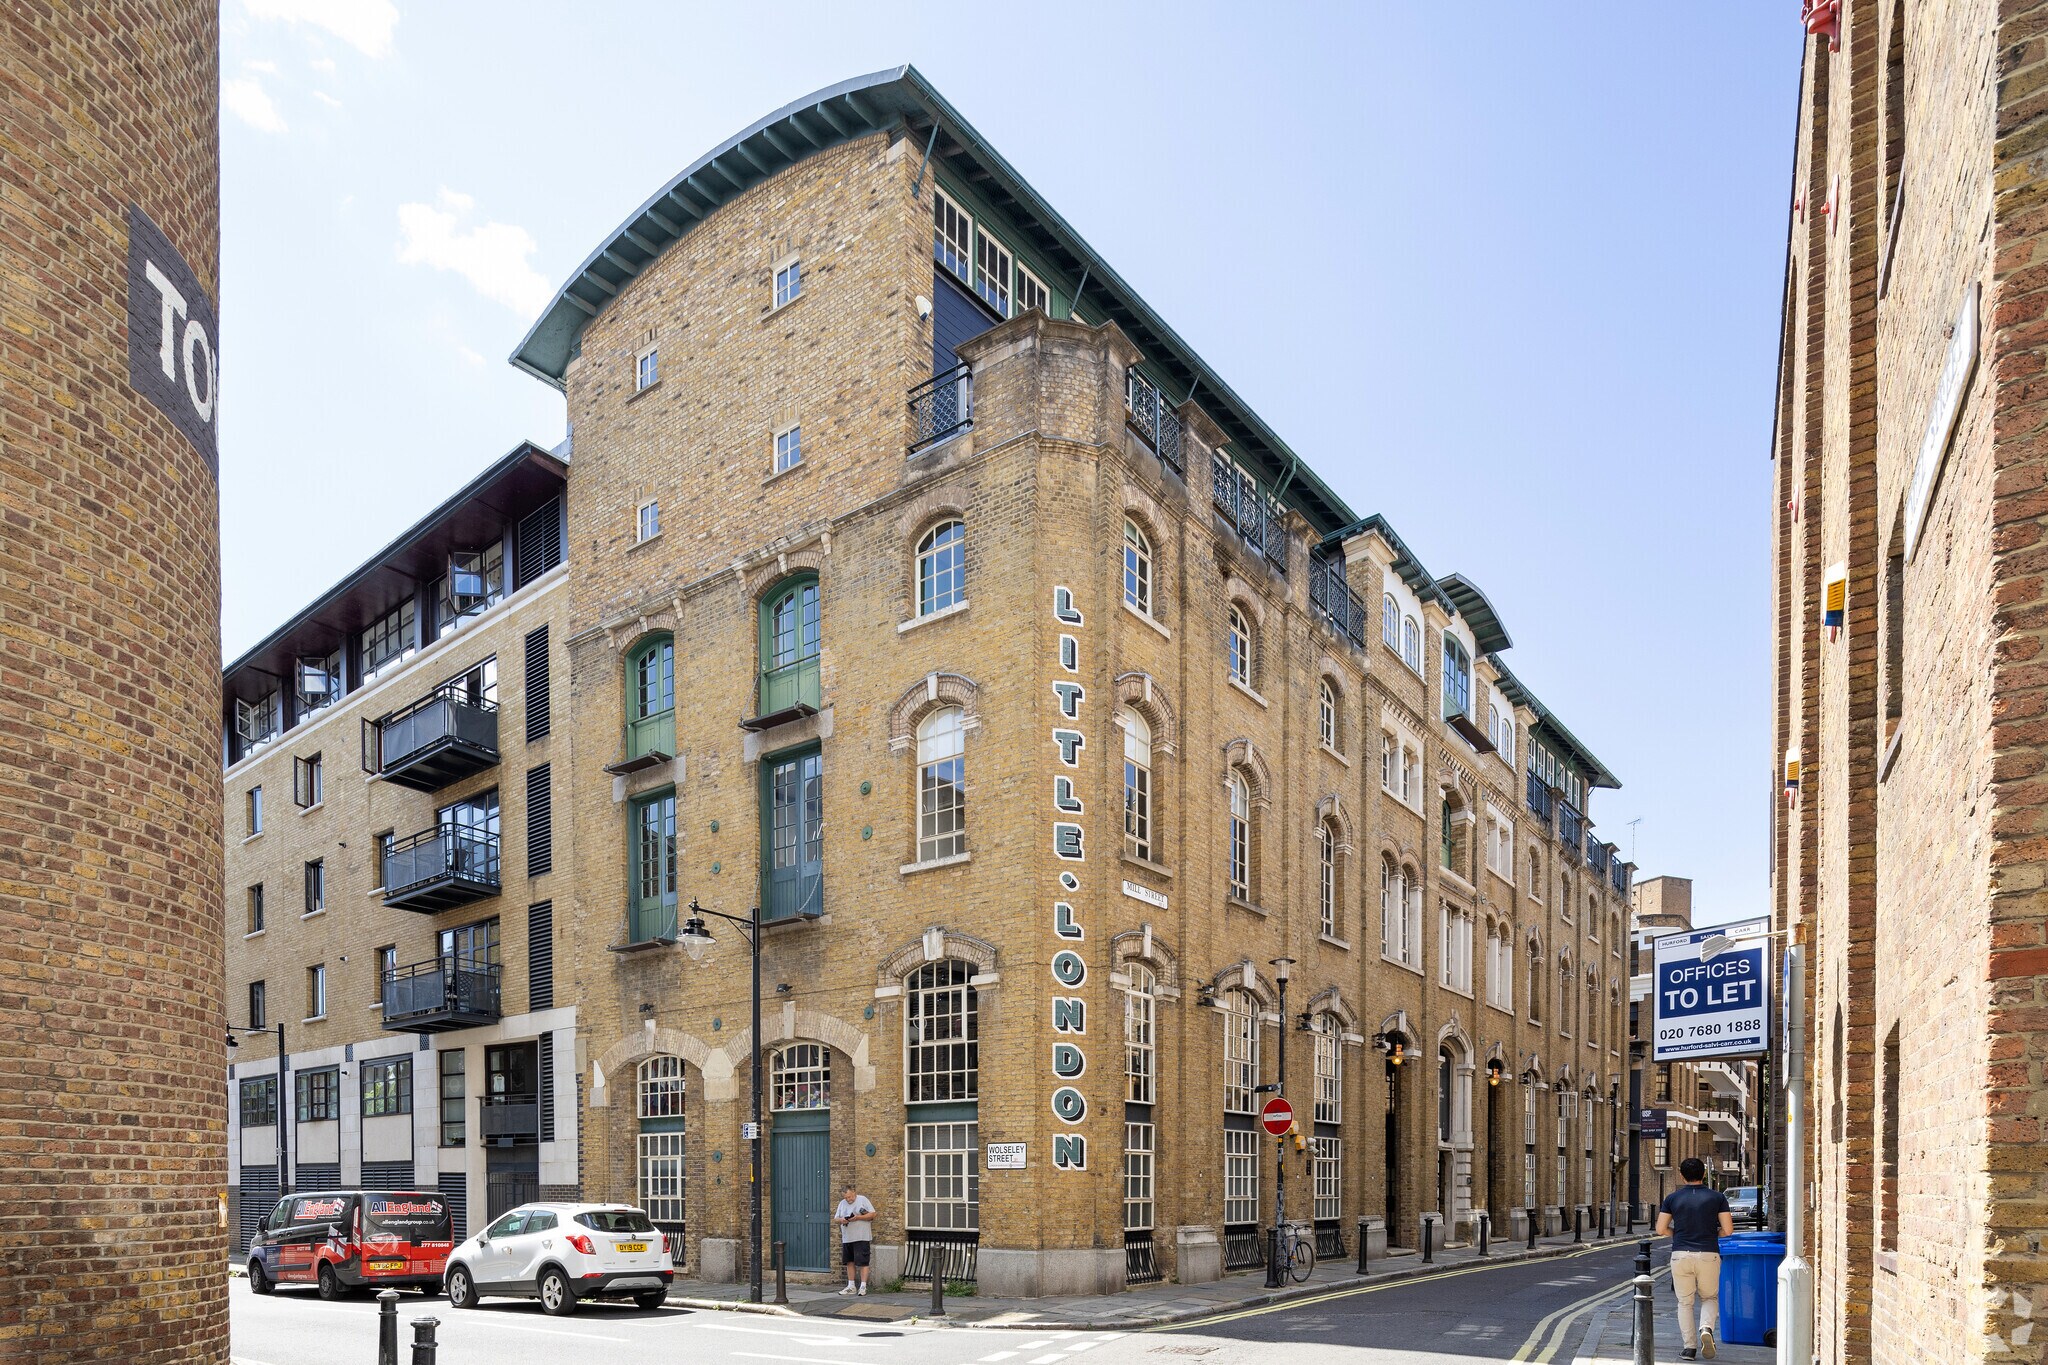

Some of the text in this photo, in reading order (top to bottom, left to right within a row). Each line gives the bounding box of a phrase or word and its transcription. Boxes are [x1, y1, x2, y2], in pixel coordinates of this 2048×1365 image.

[146, 259, 219, 452] TO
[1052, 585, 1086, 862] LITTLE
[1126, 882, 1165, 903] MILL STREET
[1670, 959, 1751, 984] OFFICES
[1664, 979, 1756, 1011] TO LET
[1051, 901, 1088, 1171] LONDON
[1660, 1019, 1761, 1040] 020 7680 1888
[1664, 1038, 1752, 1052] www.hurford-salvi-carr.co.uk
[988, 1154, 1013, 1162] STREET
[989, 1145, 1025, 1154] WOLSELEY
[293, 1200, 336, 1219] AllEngland
[371, 1201, 432, 1215] AllEngland
